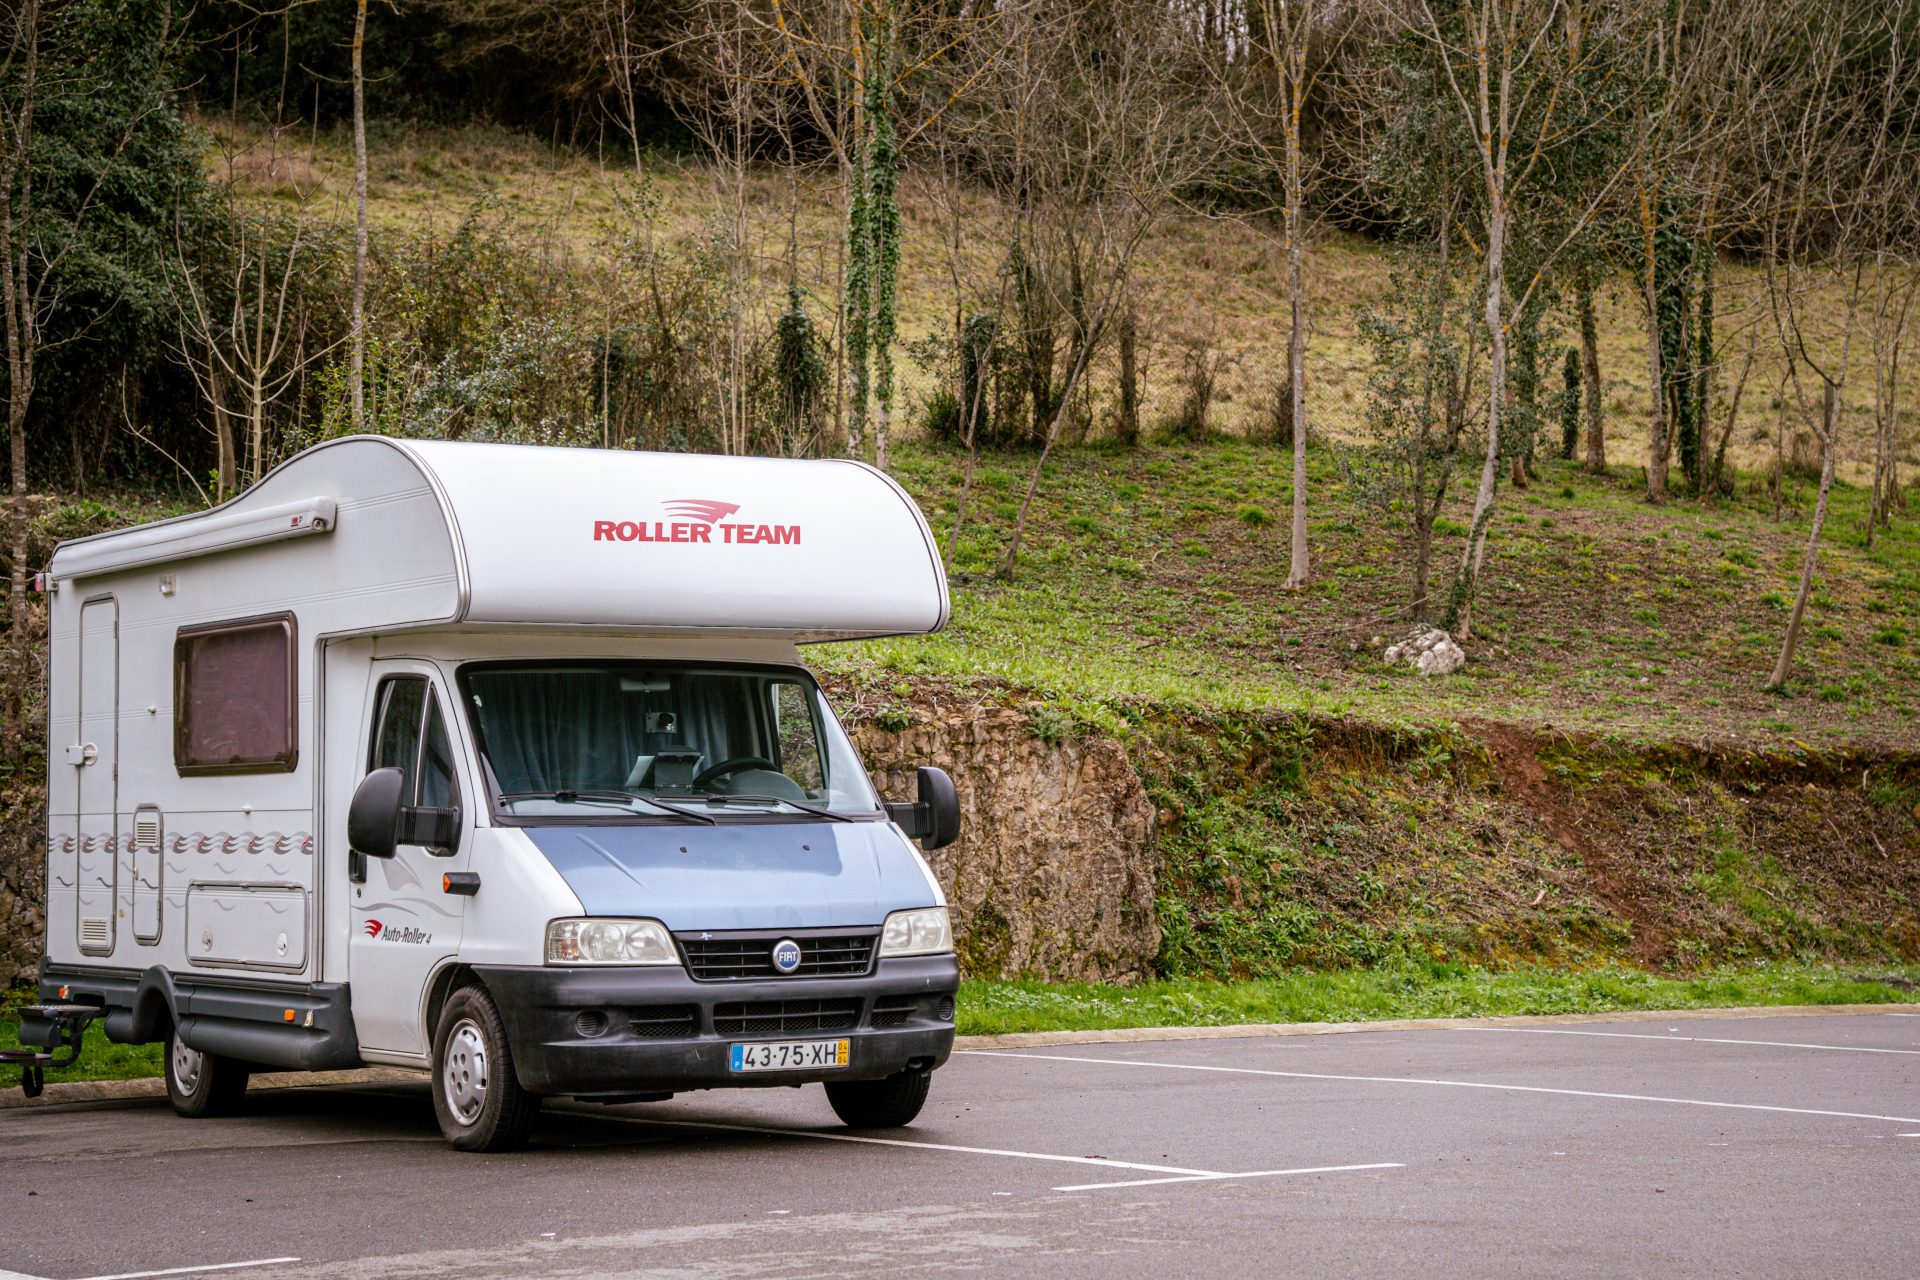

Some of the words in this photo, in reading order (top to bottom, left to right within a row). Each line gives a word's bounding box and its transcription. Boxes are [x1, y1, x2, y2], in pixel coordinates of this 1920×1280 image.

[594, 520, 711, 543] ROLLER
[719, 523, 800, 545] TEAM
[381, 924, 426, 945] Auto-Roller
[425, 933, 432, 945] 4
[778, 951, 797, 962] FIAT
